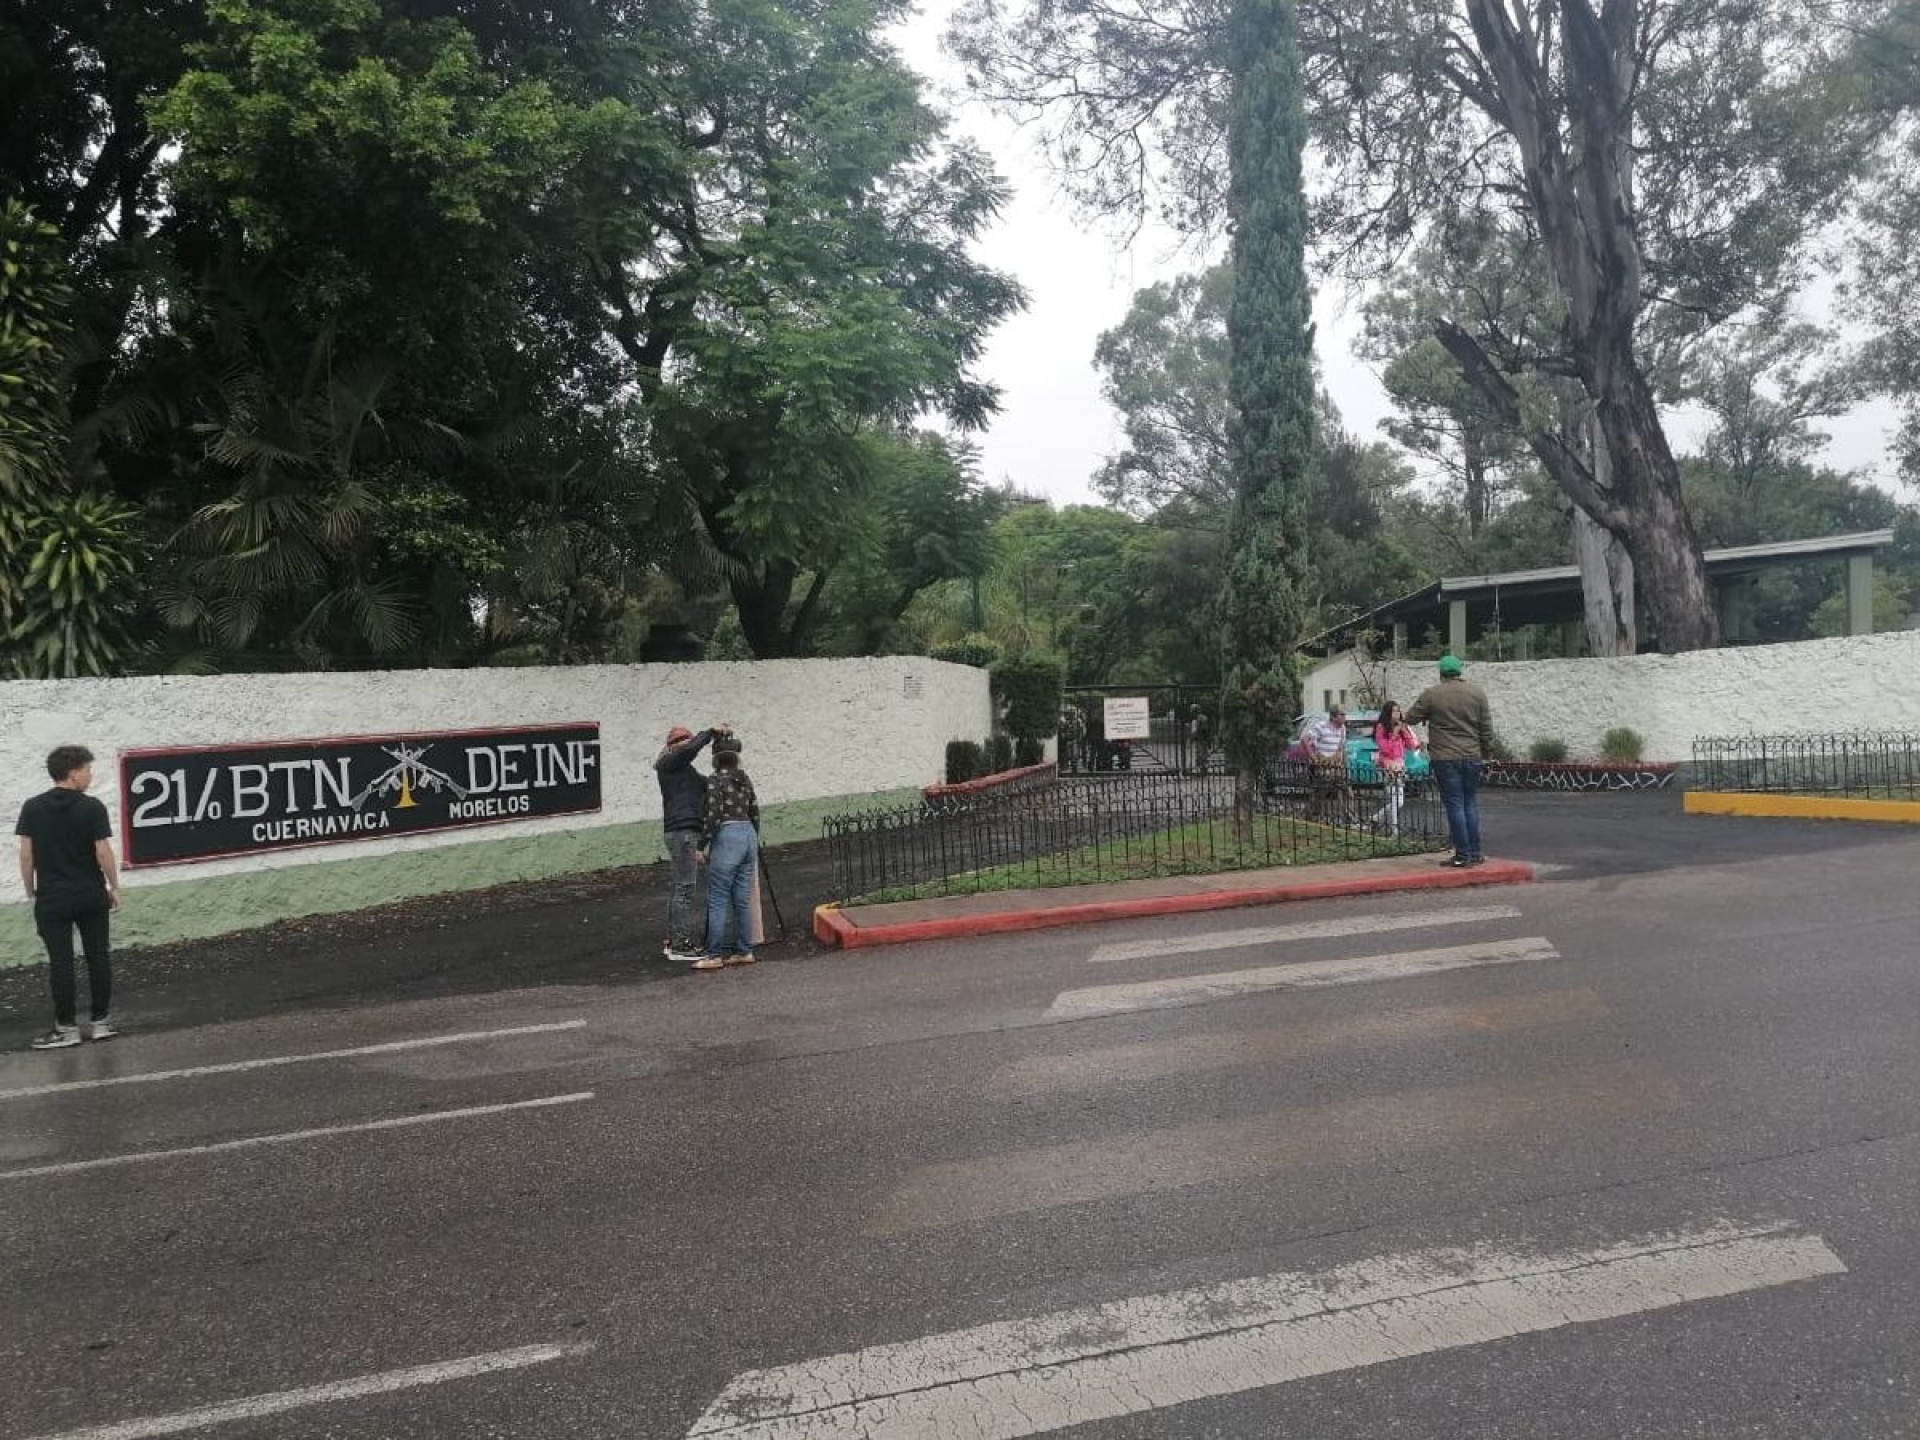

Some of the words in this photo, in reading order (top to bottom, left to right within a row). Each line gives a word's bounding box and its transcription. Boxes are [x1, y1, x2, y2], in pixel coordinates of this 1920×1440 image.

[228, 756, 352, 818] BTN
[252, 810, 390, 842] CUERNAVACA
[449, 795, 530, 819] MORELOS
